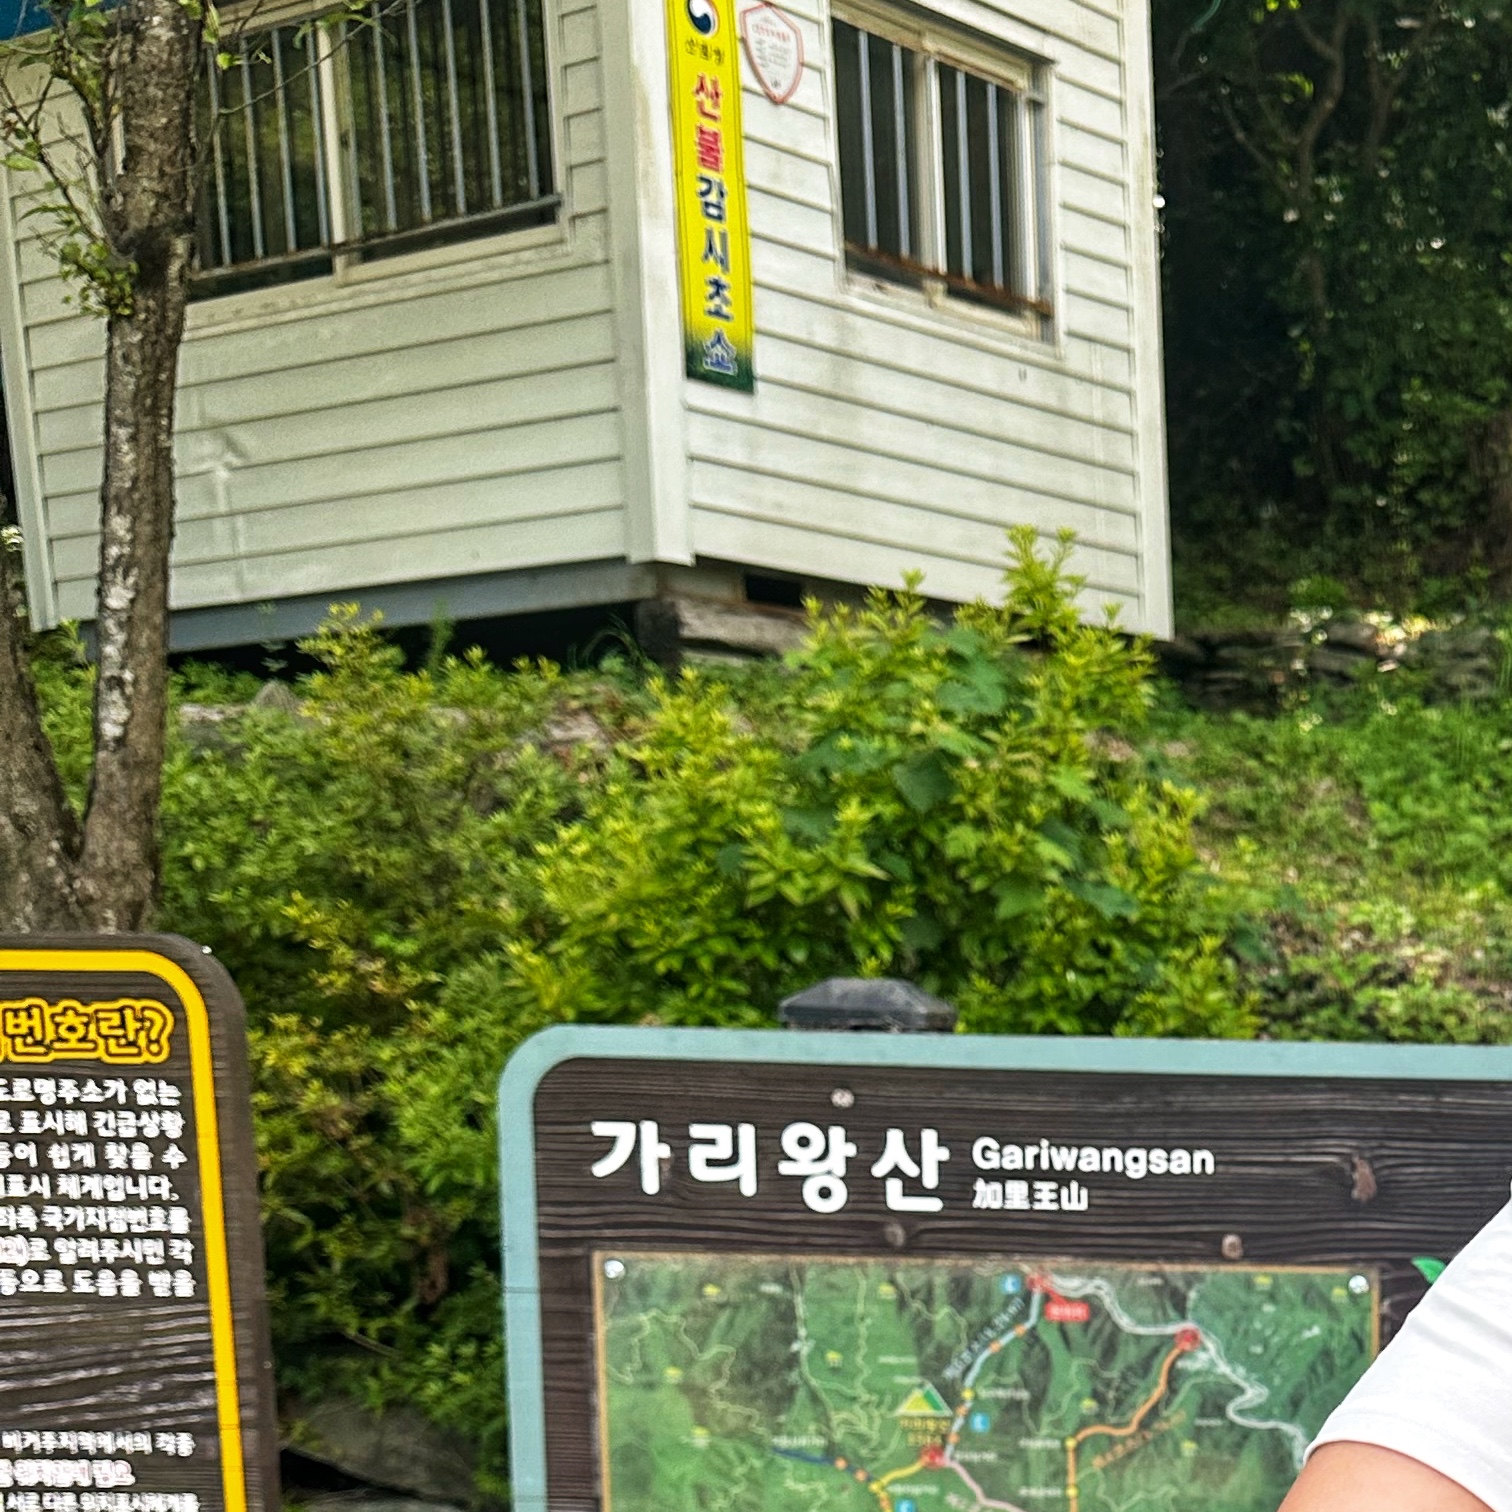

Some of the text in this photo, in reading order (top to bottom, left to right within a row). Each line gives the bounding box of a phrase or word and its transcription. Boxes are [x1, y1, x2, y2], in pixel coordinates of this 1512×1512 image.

[692, 72, 738, 376] 산불감시초소
[0, 1000, 171, 1061] 번호란?
[161, 1142, 188, 1170] 수
[590, 1119, 1216, 1213] 가리왕산 Gariwangsan
[0, 1173, 51, 1200] 표시
[972, 1179, 1089, 1212] 加里王山
